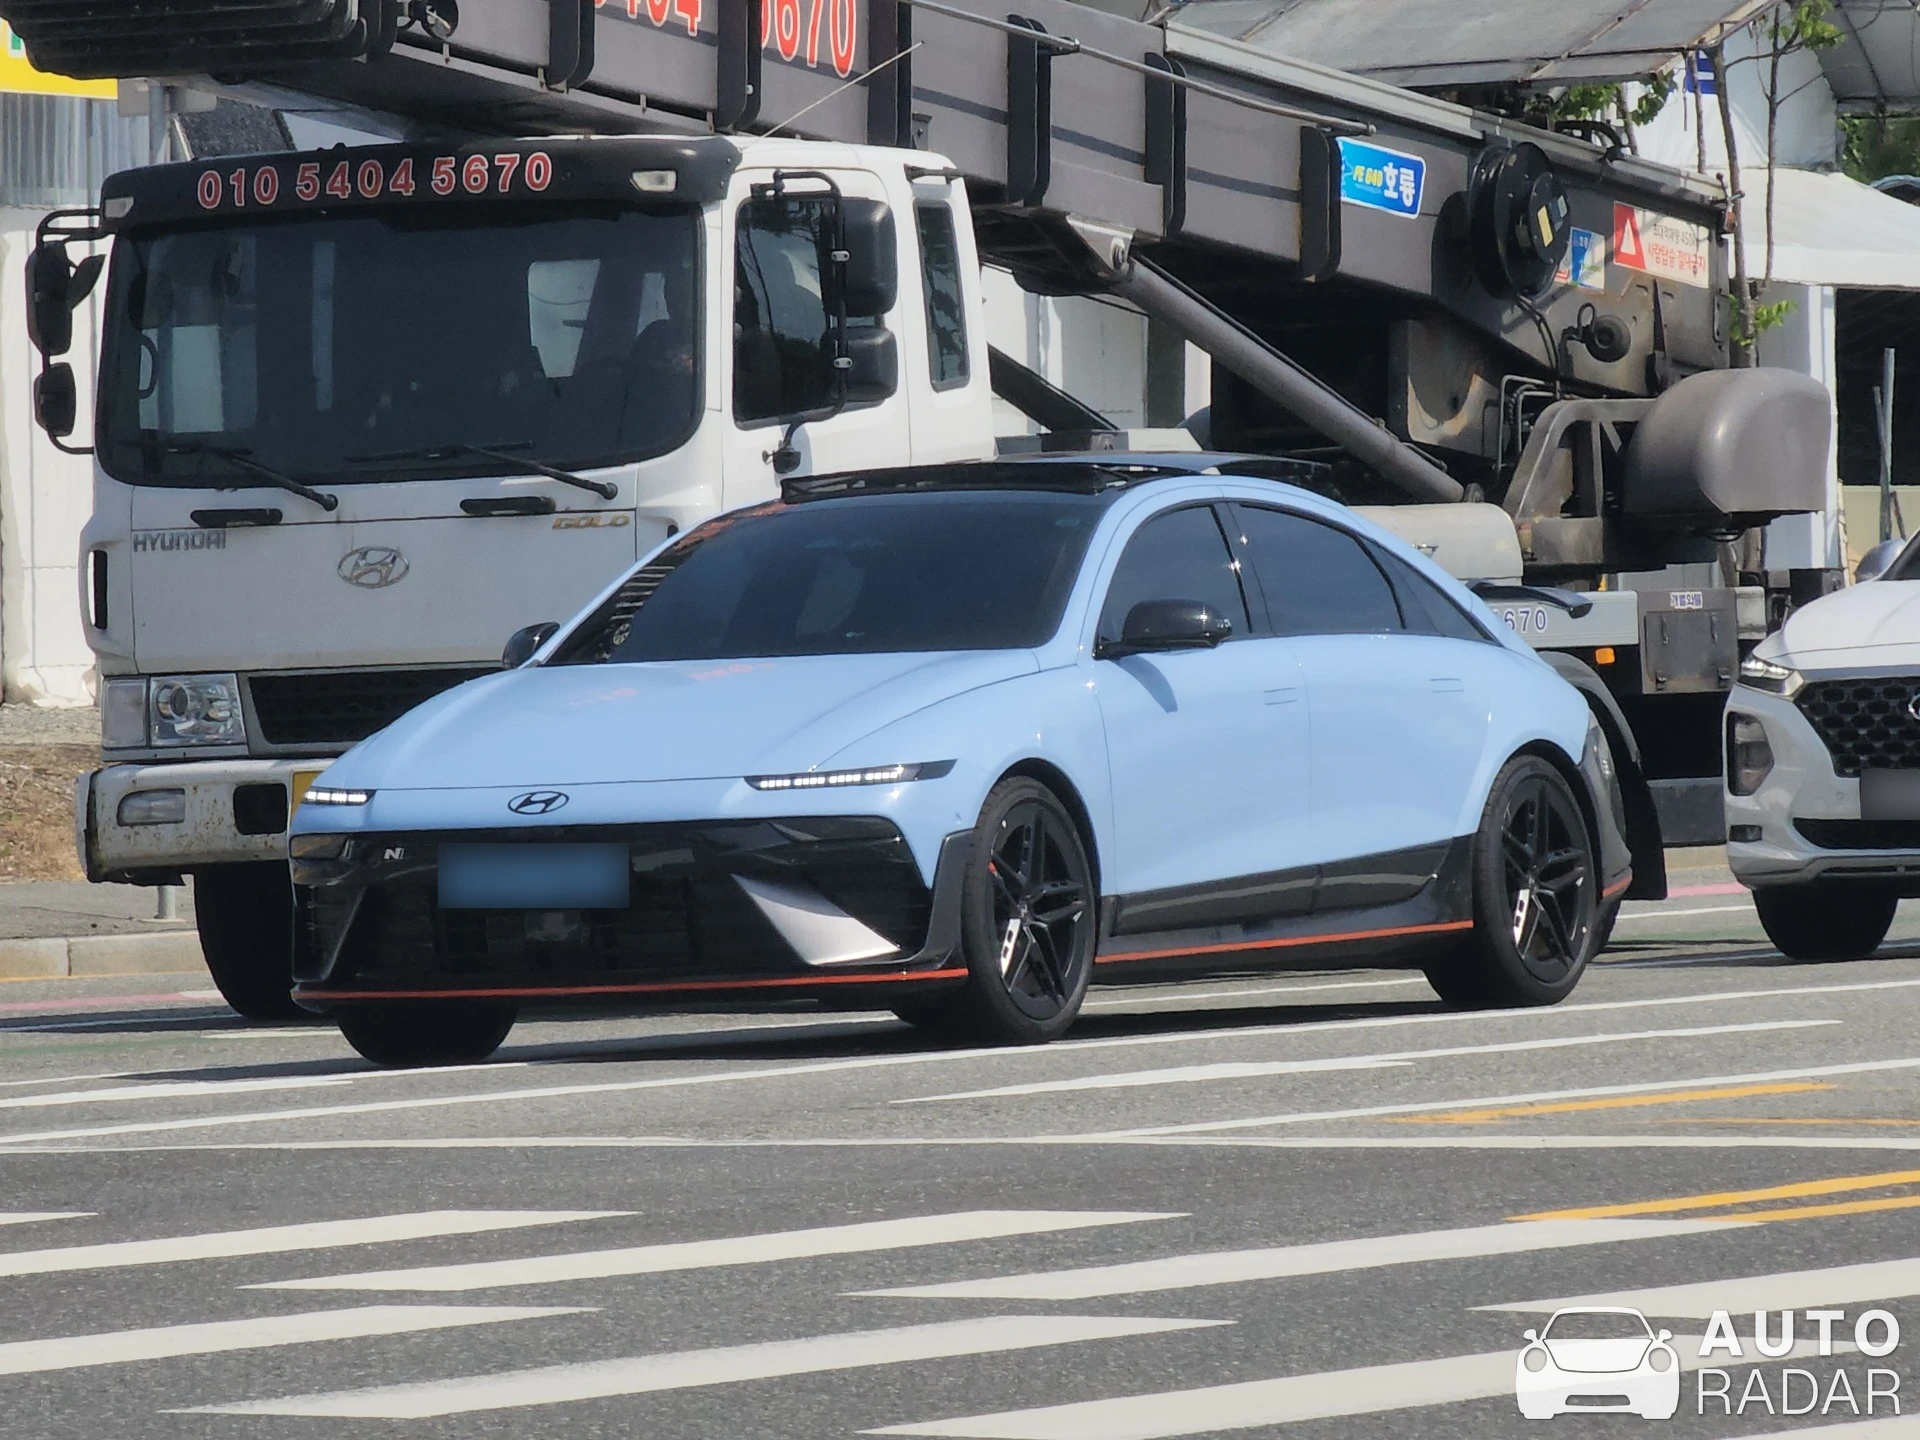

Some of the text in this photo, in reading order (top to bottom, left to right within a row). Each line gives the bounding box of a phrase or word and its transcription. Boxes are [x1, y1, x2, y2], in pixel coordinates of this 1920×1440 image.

[761, 0, 857, 78] 670
[197, 151, 552, 209] 010 5404 5670
[132, 530, 227, 552] HYUNDAI
[1492, 607, 1548, 633] 670
